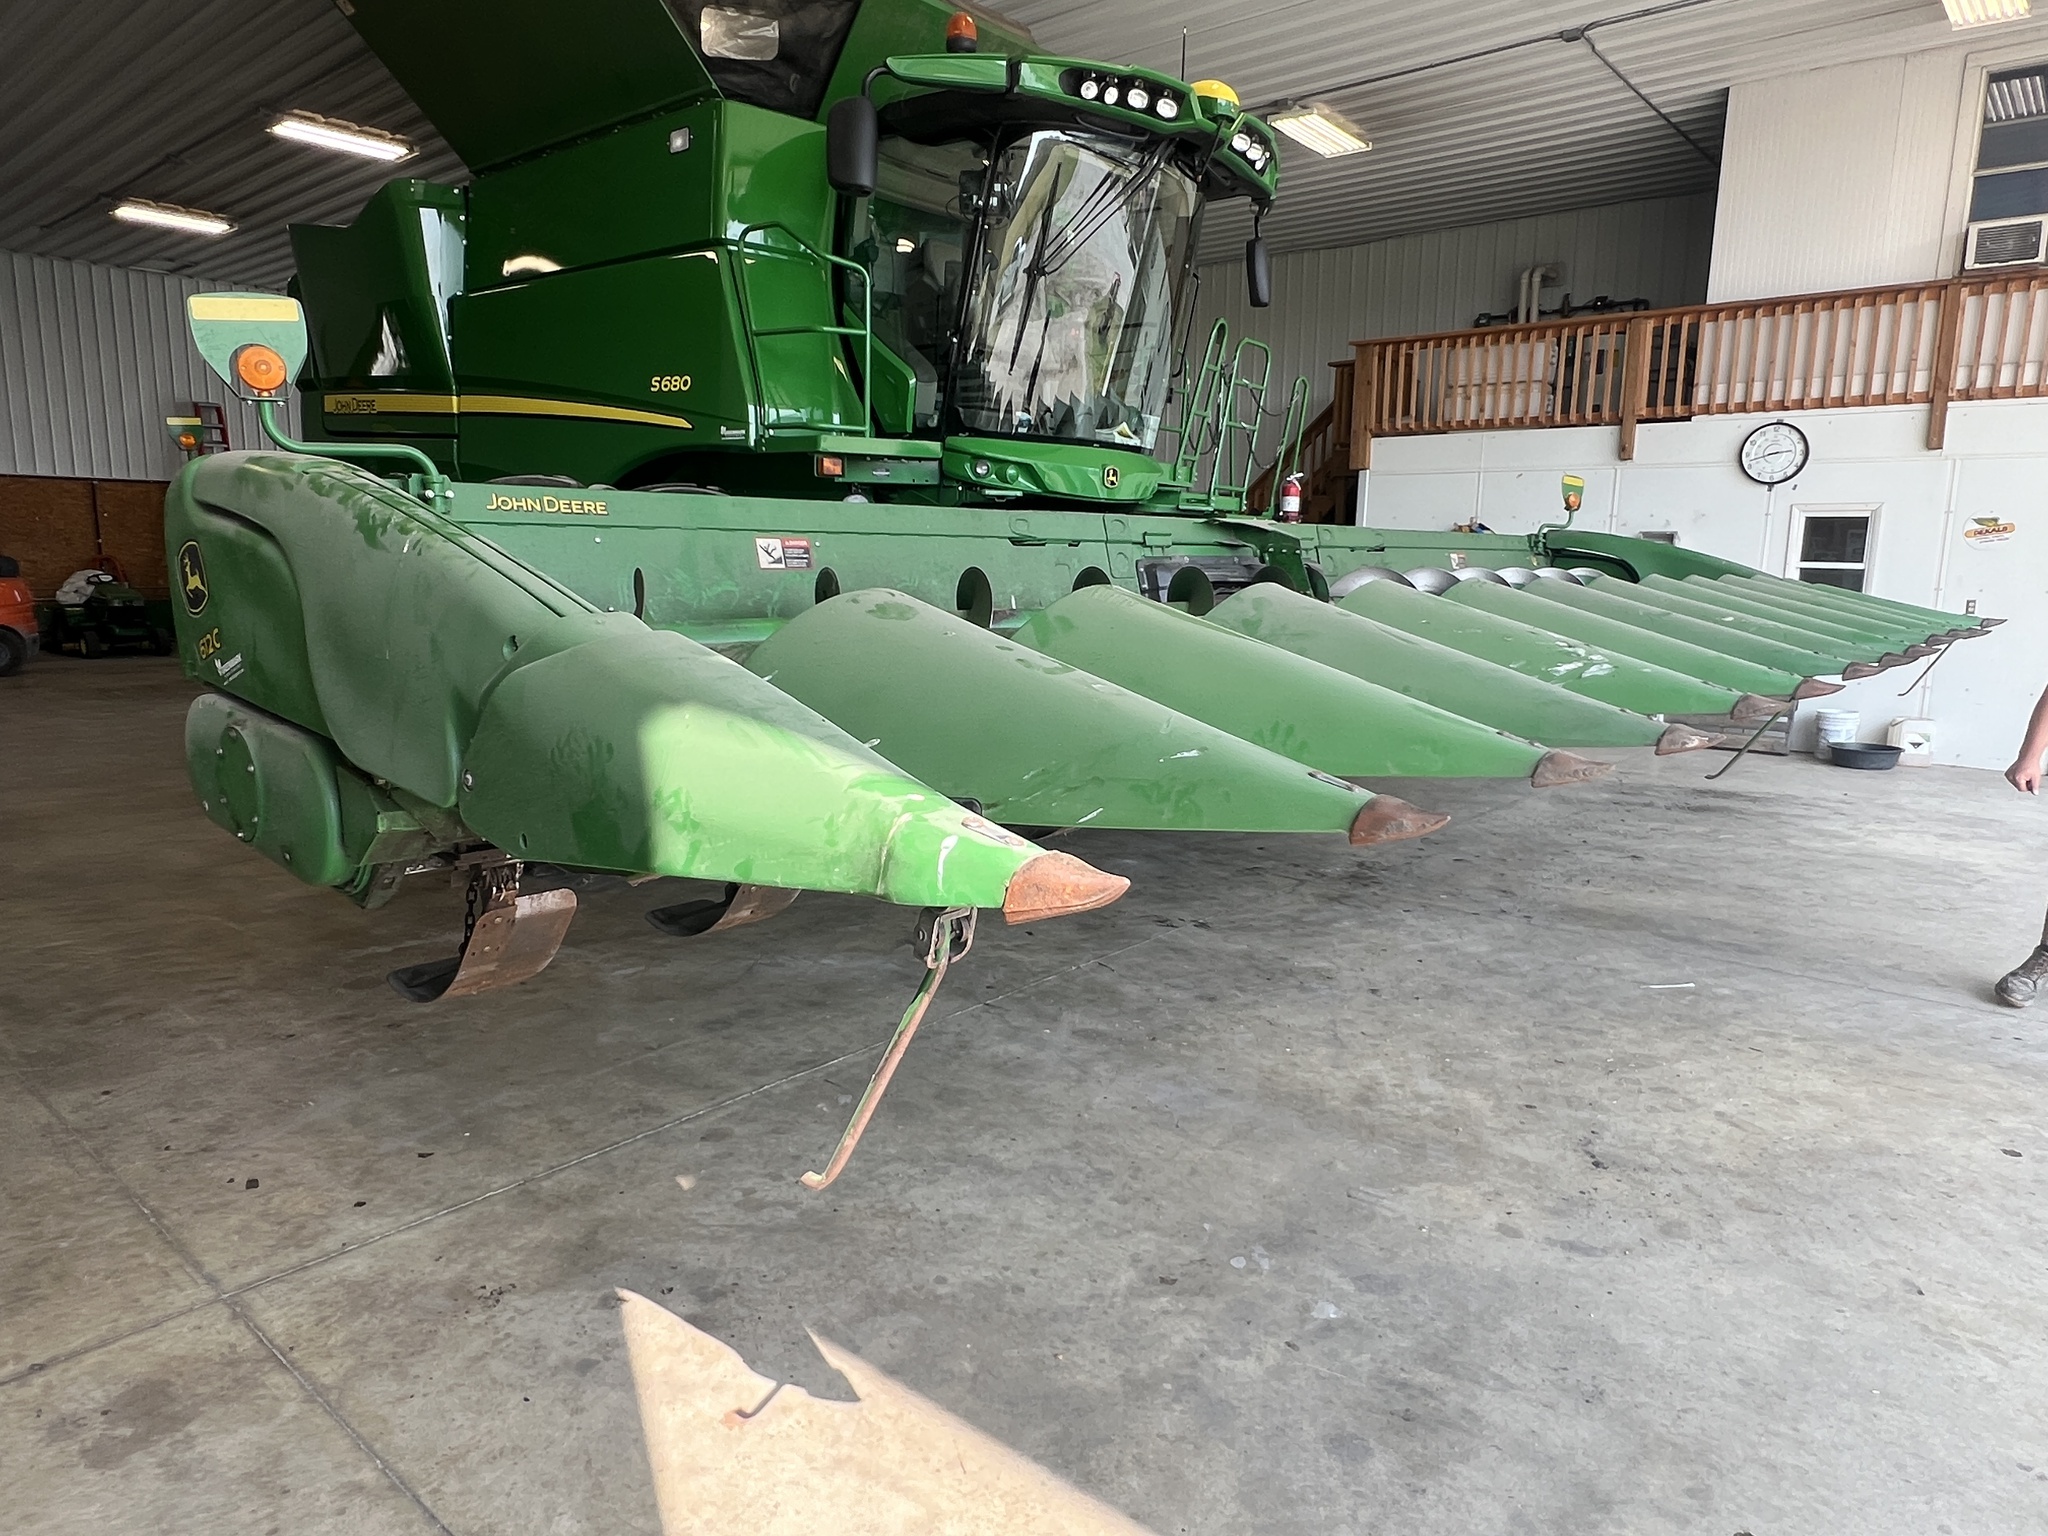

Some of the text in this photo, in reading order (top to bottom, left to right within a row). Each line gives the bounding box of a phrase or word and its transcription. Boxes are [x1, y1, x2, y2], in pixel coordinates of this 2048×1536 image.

[650, 375, 692, 392] S680
[352, 397, 377, 412] DEERE
[486, 493, 608, 515] JOHN DEERE
